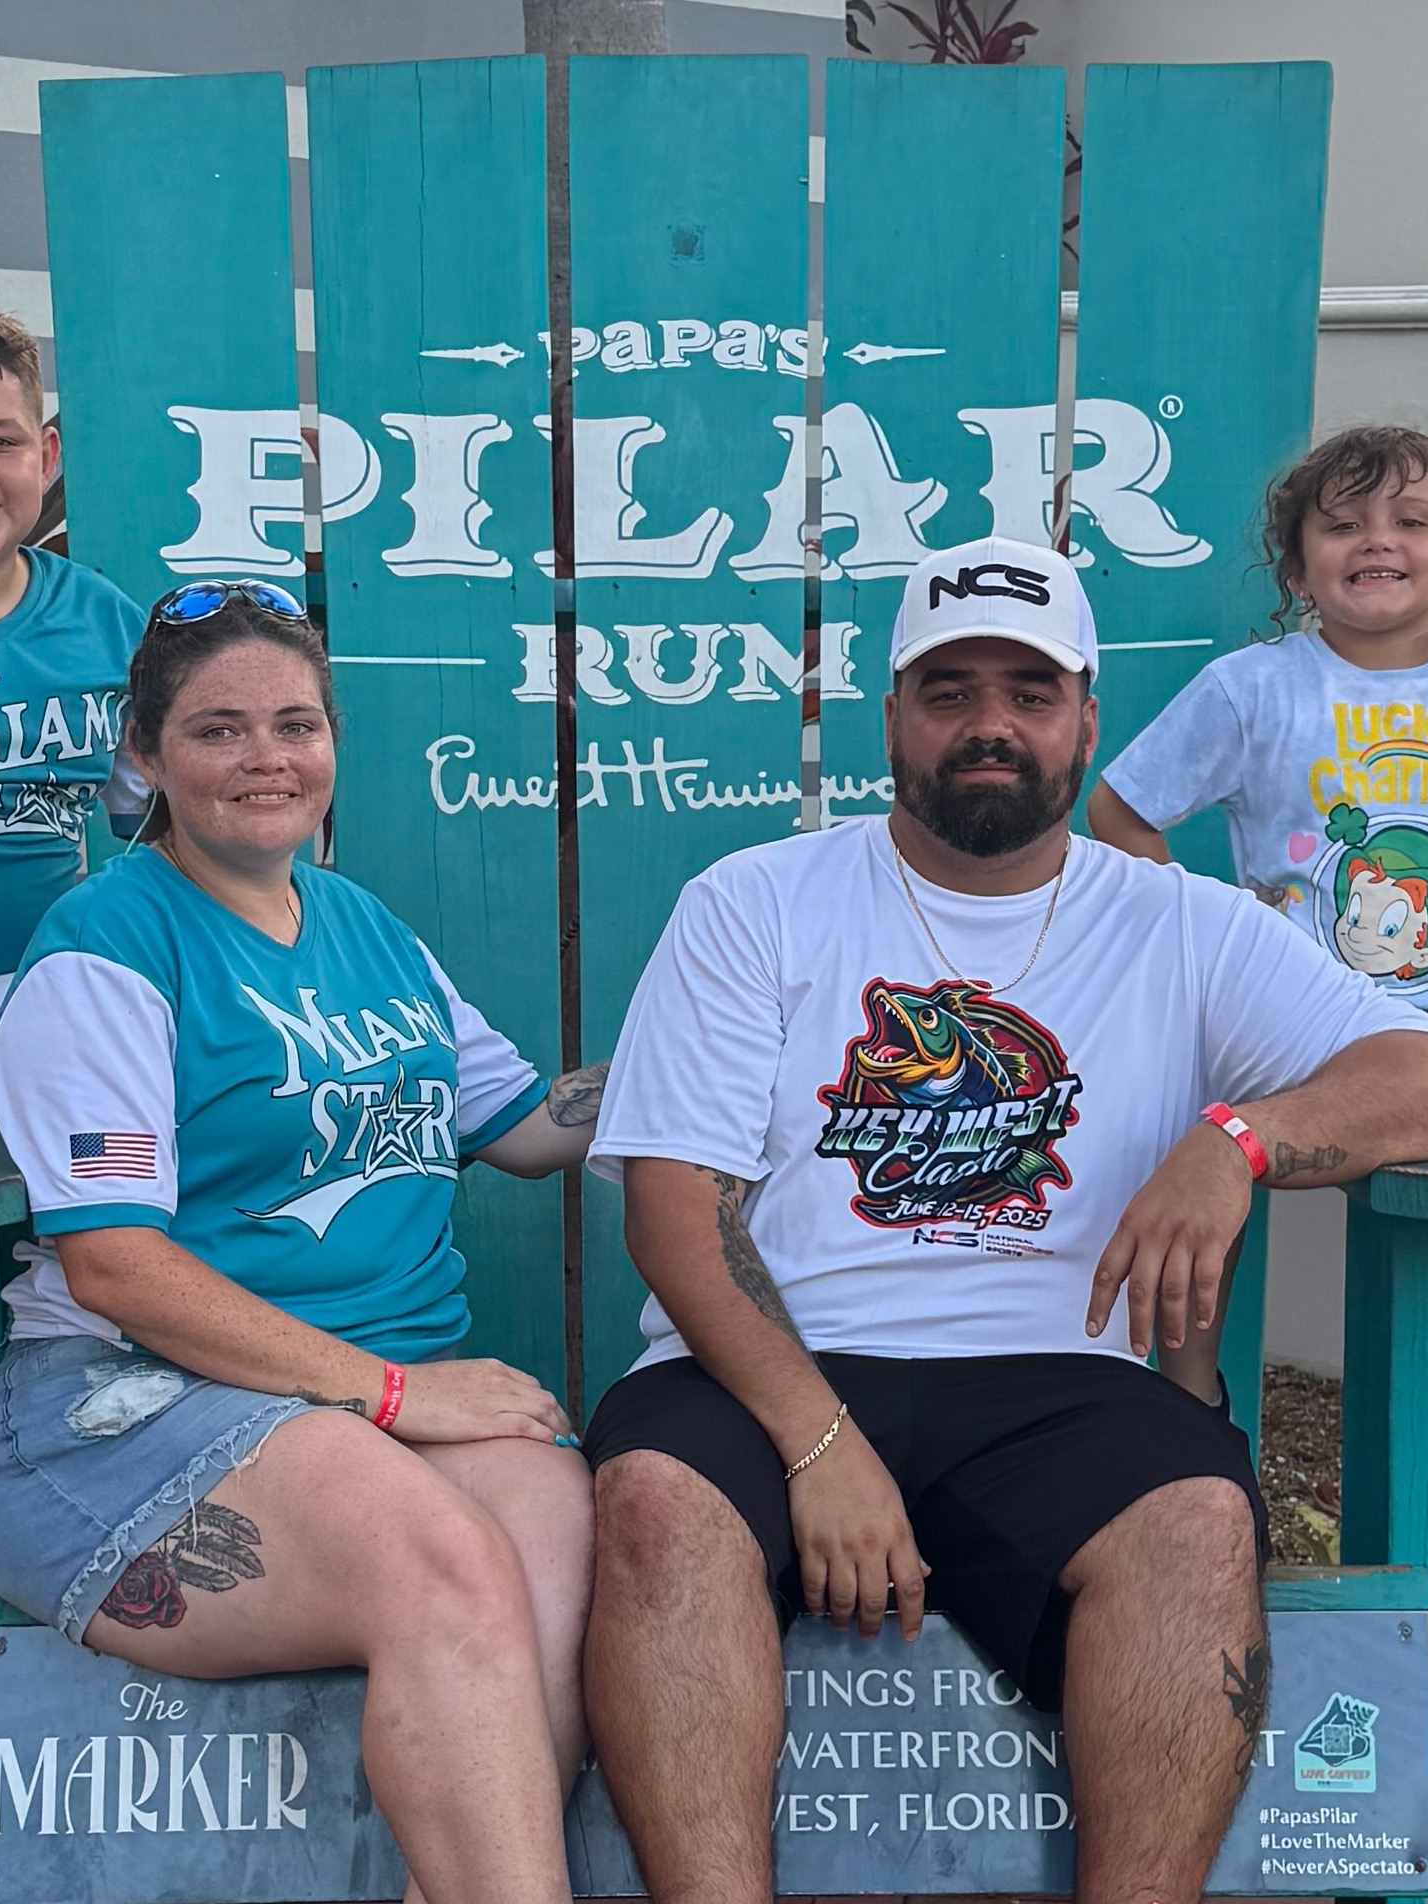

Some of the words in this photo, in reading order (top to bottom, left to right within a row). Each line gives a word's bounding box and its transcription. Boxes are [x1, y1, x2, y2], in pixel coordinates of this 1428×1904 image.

[929, 563, 1051, 611] NCS
[511, 621, 865, 706] RUM
[822, 1107, 933, 1154] KEY
[940, 1080, 1078, 1152] WEST
[886, 1193, 937, 1219] JUNE
[996, 1207, 1048, 1228] 2025
[912, 1227, 980, 1247] NCS
[120, 1682, 188, 1722] The
[933, 1669, 1031, 1707] FRO
[776, 1730, 1064, 1770] WATERFRON
[899, 1792, 1078, 1832] FLORID
[1259, 1807, 1359, 1828] #PapasPilar
[1260, 1832, 1411, 1850] #LoveTheMarker
[1261, 1859, 1420, 1878] #NeverASpectato
